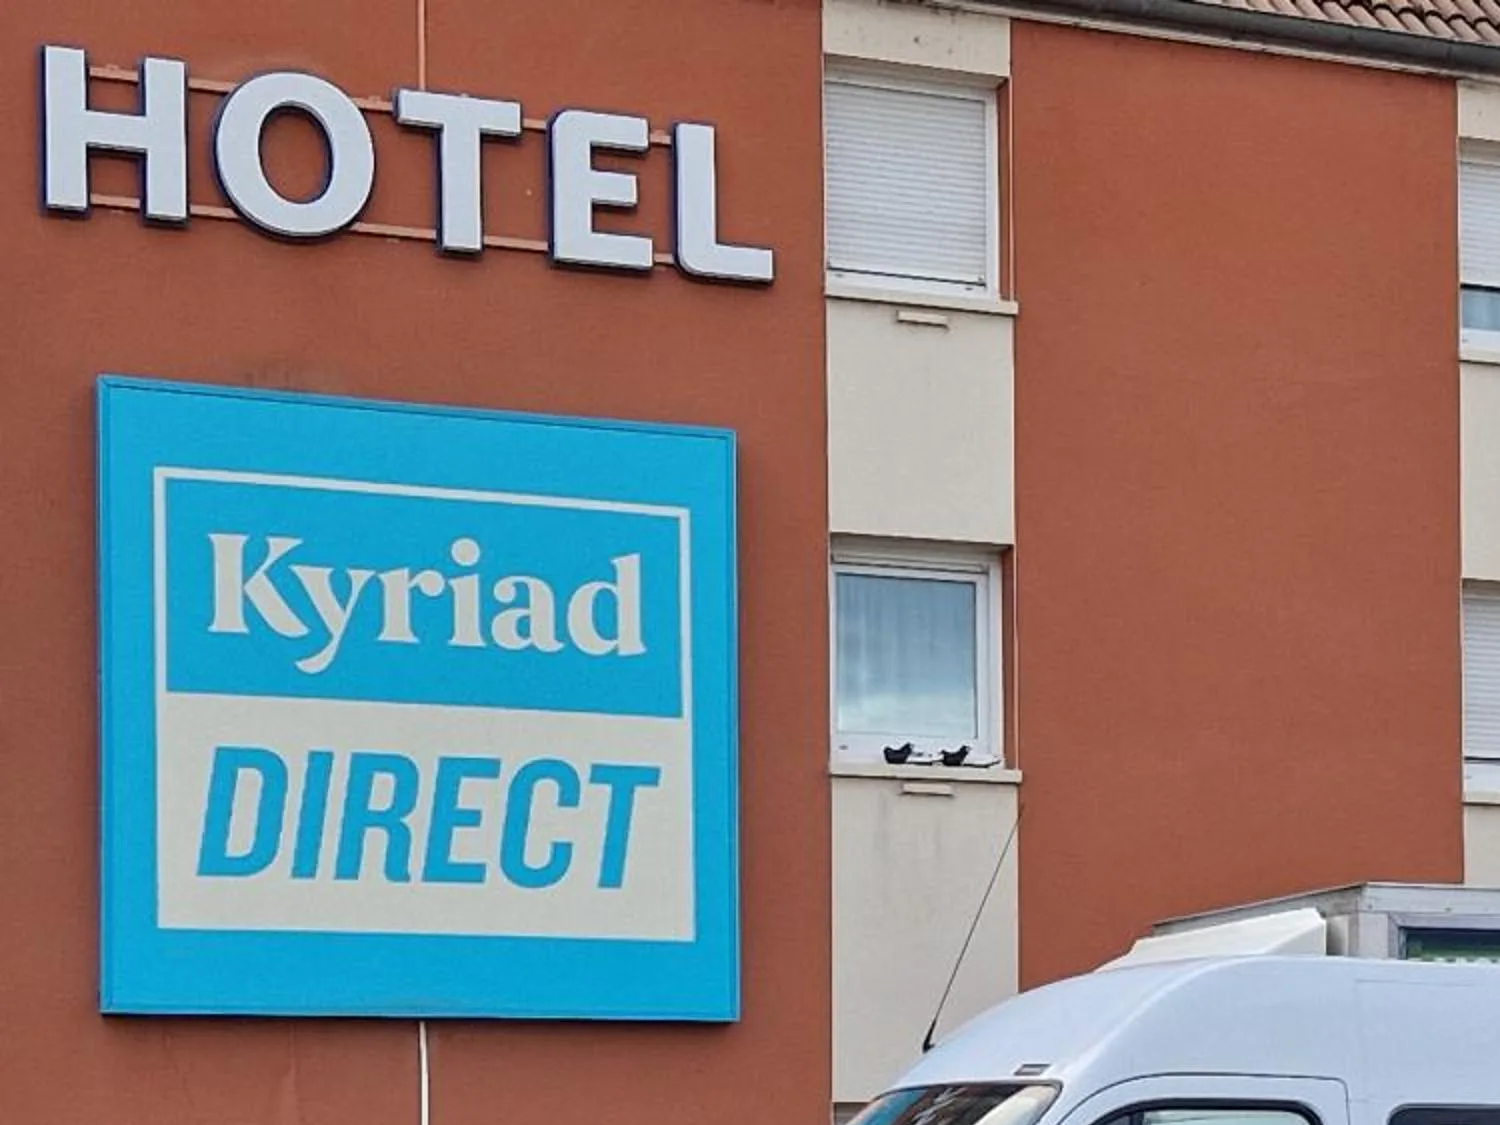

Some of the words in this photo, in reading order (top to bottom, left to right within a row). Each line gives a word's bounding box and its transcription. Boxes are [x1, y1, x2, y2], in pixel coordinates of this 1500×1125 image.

[42, 44, 775, 284] HOTEL
[207, 532, 647, 674] Kyriad
[196, 746, 661, 890] DIRECT
